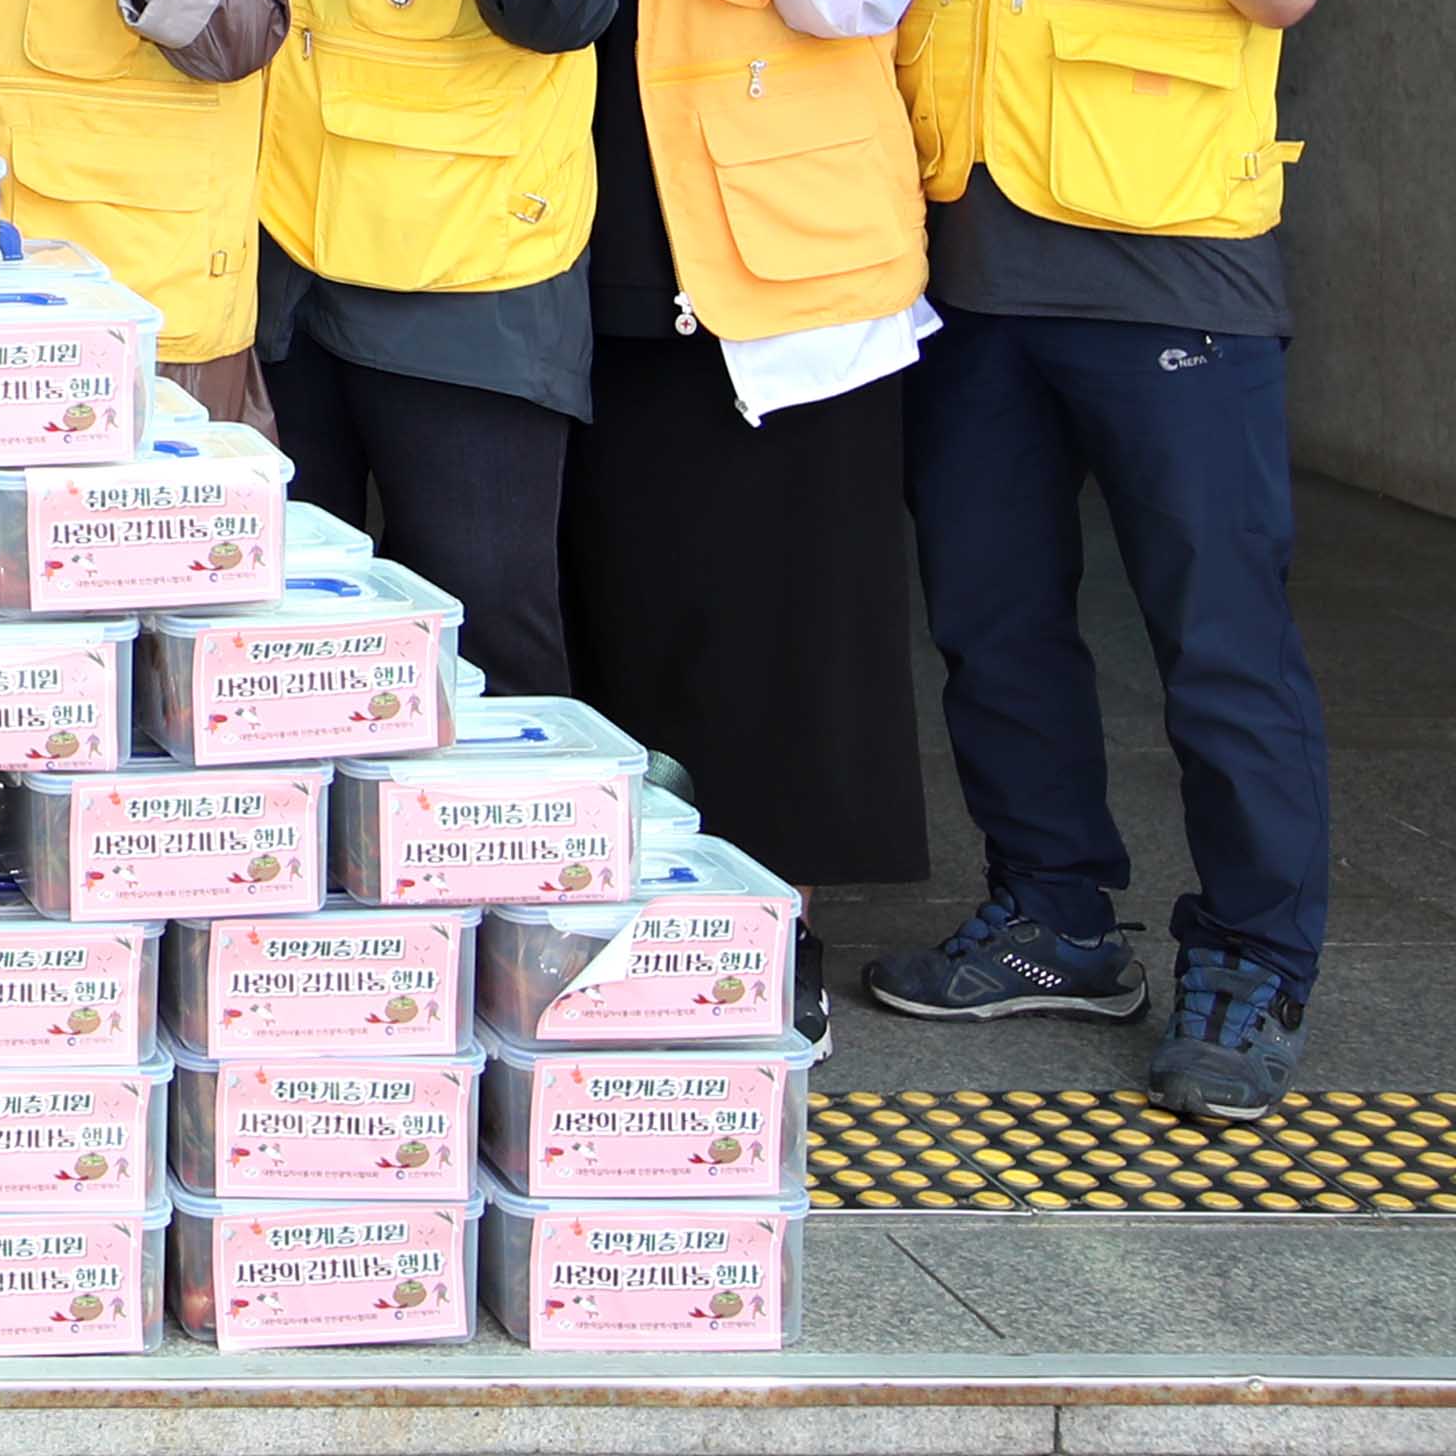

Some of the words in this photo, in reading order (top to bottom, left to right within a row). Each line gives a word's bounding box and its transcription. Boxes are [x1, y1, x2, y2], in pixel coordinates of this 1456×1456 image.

[36, 343, 79, 364] 지원
[69, 375, 114, 397] 행사
[85, 486, 172, 509] 취약계층
[180, 483, 223, 504] 지원
[53, 521, 115, 545] 사랑의
[121, 517, 208, 542] 김치나눔
[214, 513, 260, 536] 행사
[633, 918, 681, 940] 계층
[689, 918, 731, 939] 지원
[265, 939, 353, 959] 취약계층
[359, 938, 402, 957] 지원
[629, 952, 713, 974] 김치나눔
[720, 951, 764, 971] 행사
[232, 972, 295, 993] 사랑의
[300, 971, 386, 993] 김치나눔
[391, 968, 437, 990] 행사
[588, 1078, 676, 1098] 취약계층
[682, 1078, 727, 1097] 지원
[554, 1110, 618, 1132] 사랑의
[622, 1111, 710, 1132] 김치나눔
[715, 1109, 761, 1131] 행사
